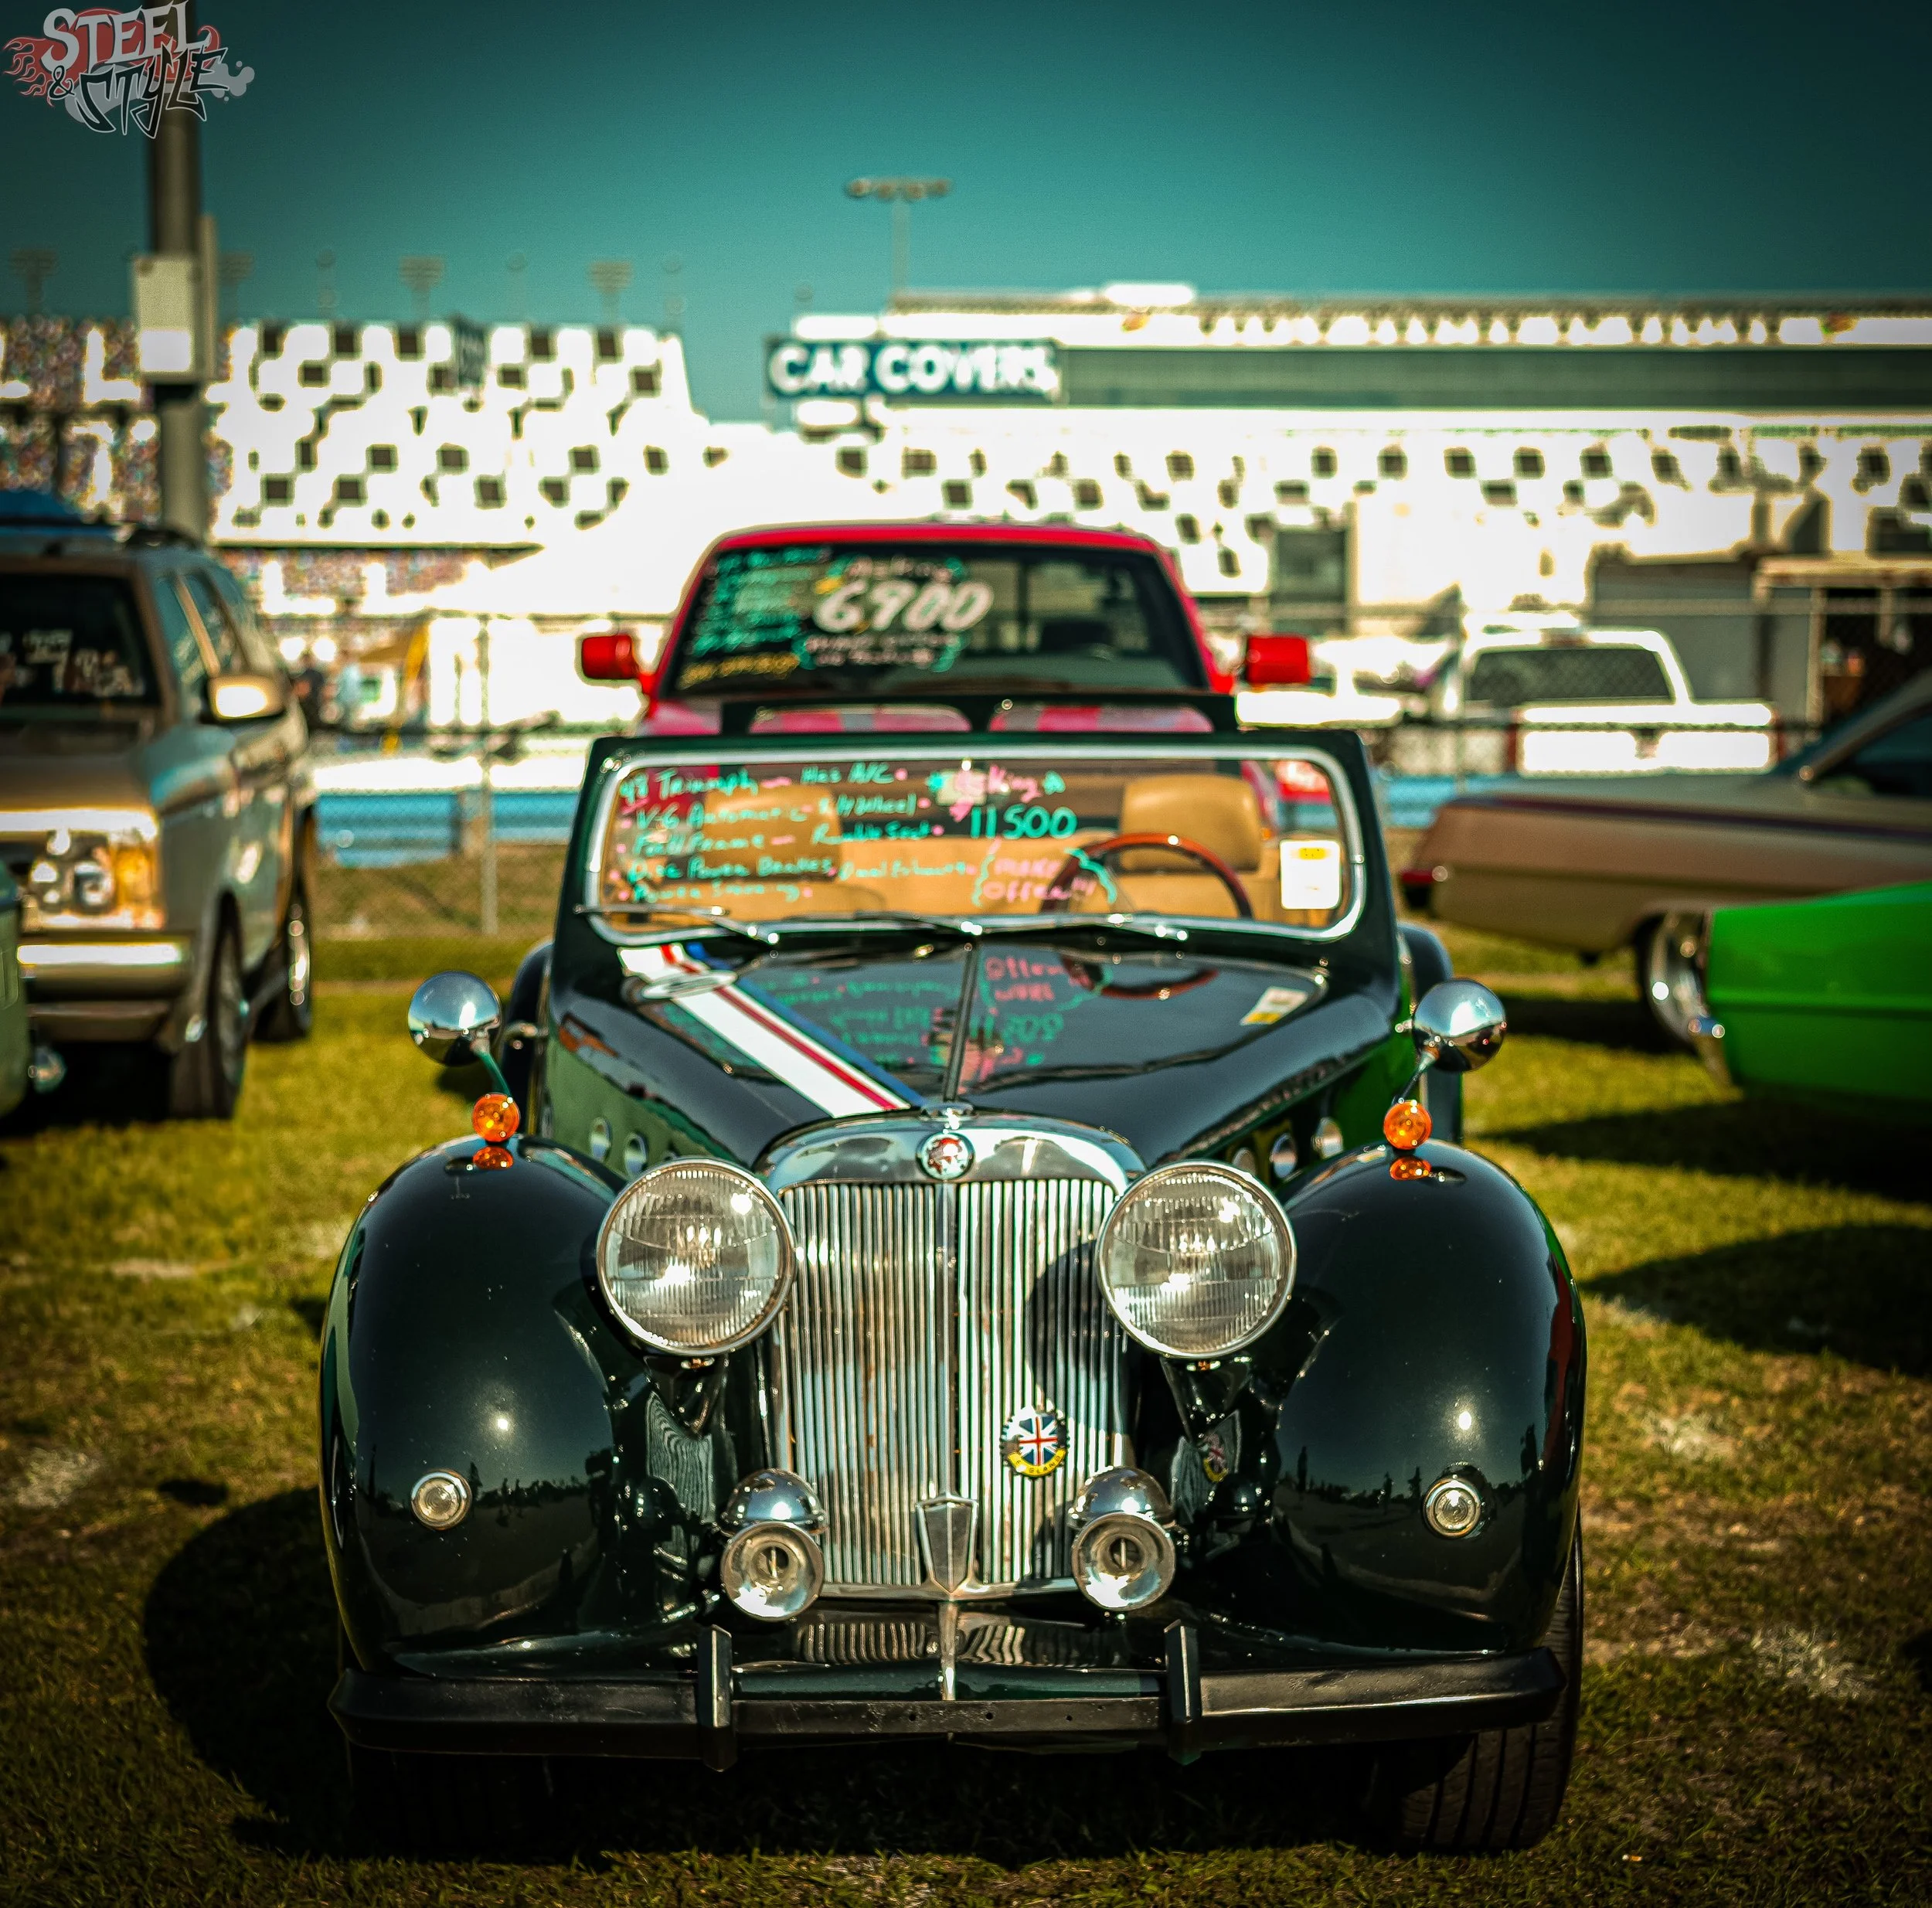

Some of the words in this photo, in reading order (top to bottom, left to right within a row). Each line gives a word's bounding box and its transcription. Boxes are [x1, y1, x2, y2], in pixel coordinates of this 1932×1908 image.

[770, 345, 867, 393] CAR
[874, 345, 1061, 396] COVERS
[815, 579, 994, 633] 6900
[970, 803, 1078, 839] 11500
[1015, 1455, 1062, 1474] EGLAND
